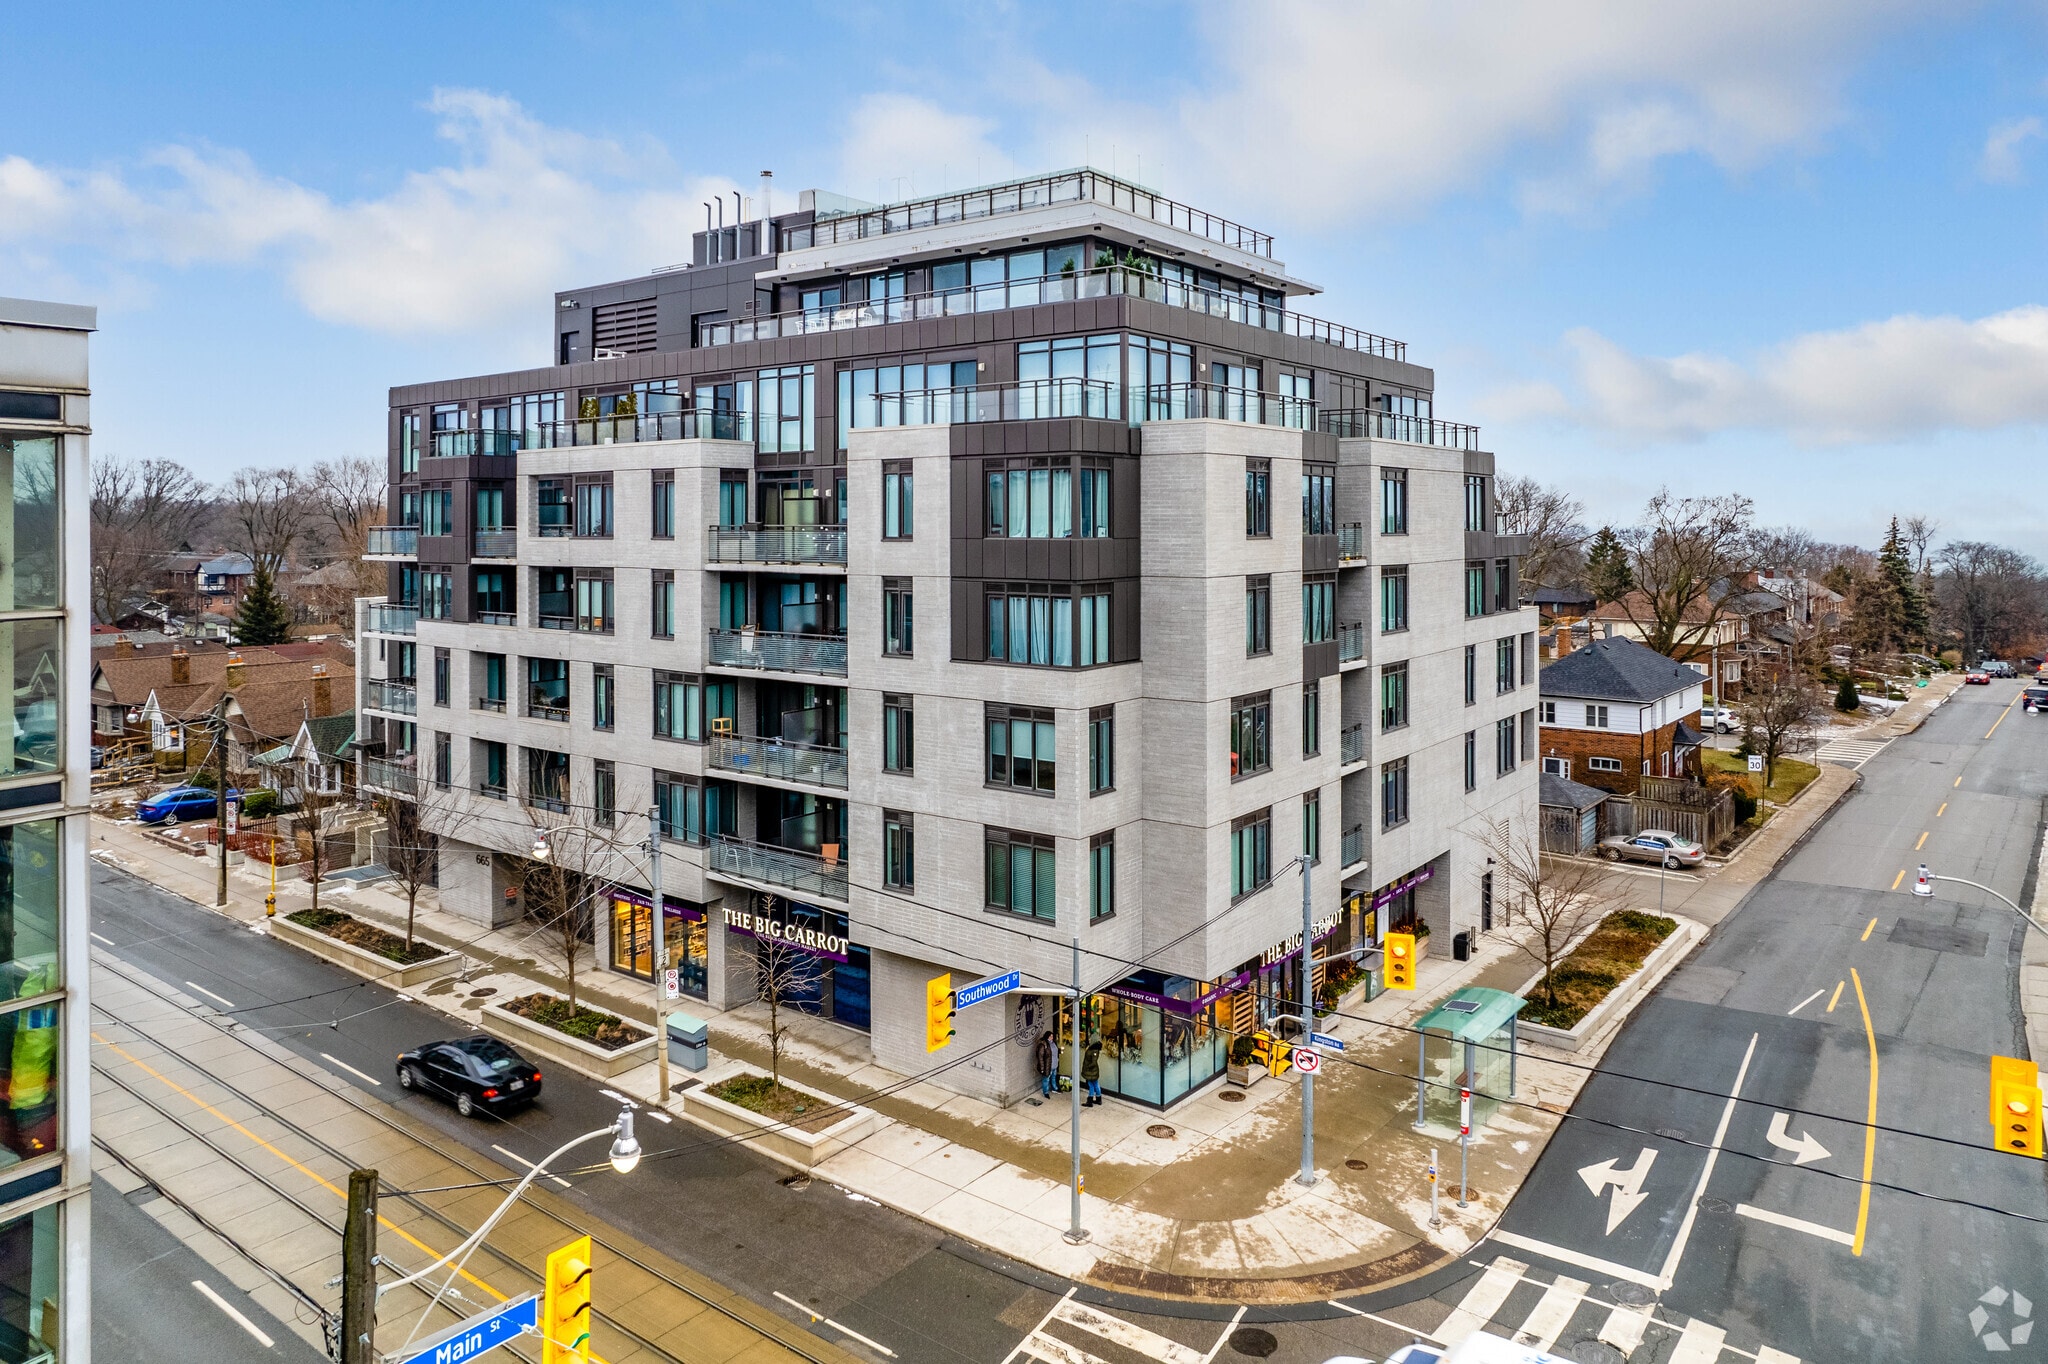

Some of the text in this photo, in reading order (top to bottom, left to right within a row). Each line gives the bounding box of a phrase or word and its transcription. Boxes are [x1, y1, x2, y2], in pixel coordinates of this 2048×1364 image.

[1750, 762, 1761, 770] 30
[476, 854, 490, 867] 665
[722, 907, 849, 956] THE BIG CARROT
[1259, 941, 1283, 968] THE
[1284, 930, 1303, 955] BIG
[959, 973, 1018, 1005] Southwood Dr
[1111, 987, 1159, 1004] WHOLE BODY CARE
[1314, 1035, 1334, 1047] Kingston
[435, 1319, 501, 1364] Main St
